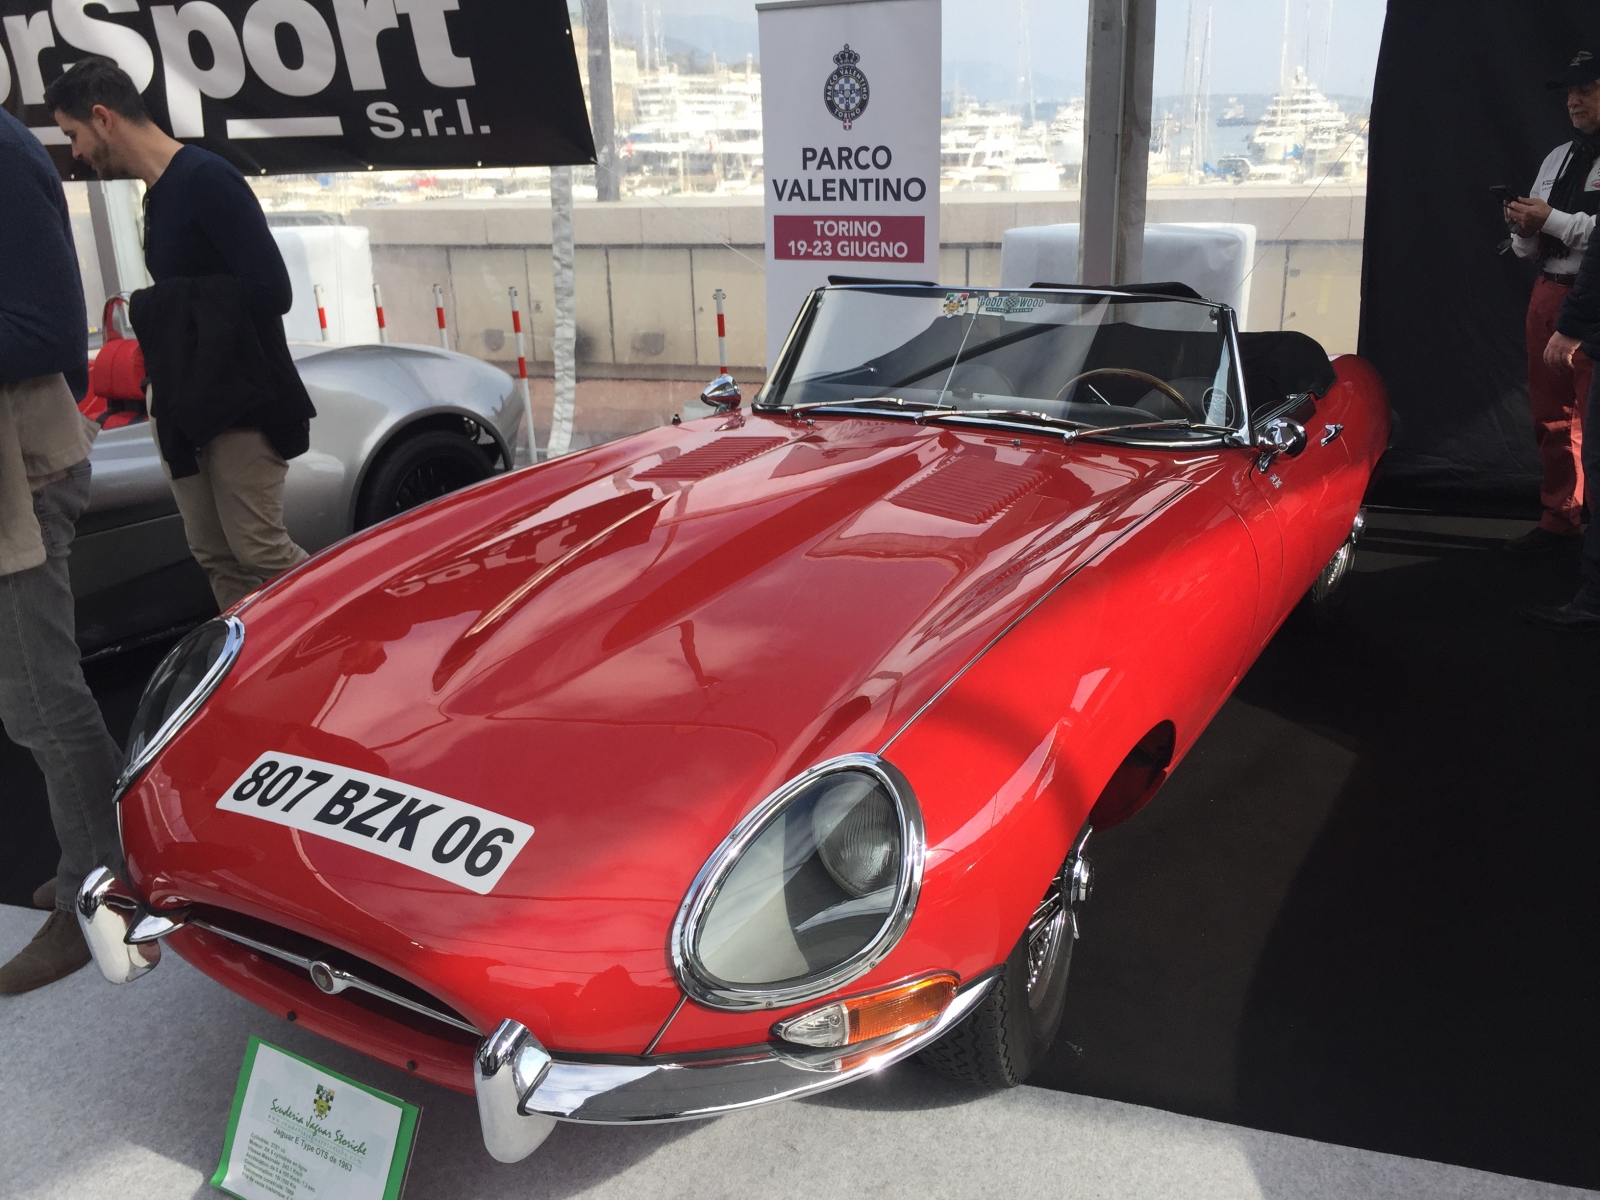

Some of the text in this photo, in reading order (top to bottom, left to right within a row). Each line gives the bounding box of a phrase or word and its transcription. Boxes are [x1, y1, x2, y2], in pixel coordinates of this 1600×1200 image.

[0, 0, 476, 138] rSport
[365, 99, 491, 139] S.r.l.
[802, 145, 892, 170] PARCO
[772, 177, 926, 202] VALENTINO
[813, 220, 882, 237] TORINO
[788, 240, 908, 258] 19-23 GIUGNO
[1020, 297, 1045, 308] WOOD
[232, 760, 515, 877] 807 BZK 06
[270, 1098, 367, 1156] Scuderia Jaguar Storiche
[273, 1127, 294, 1142] Jaguar
[300, 1139, 315, 1152] Type
[315, 1147, 328, 1160] OTS
[330, 1154, 337, 1164] de
[338, 1160, 353, 1172] 1963
